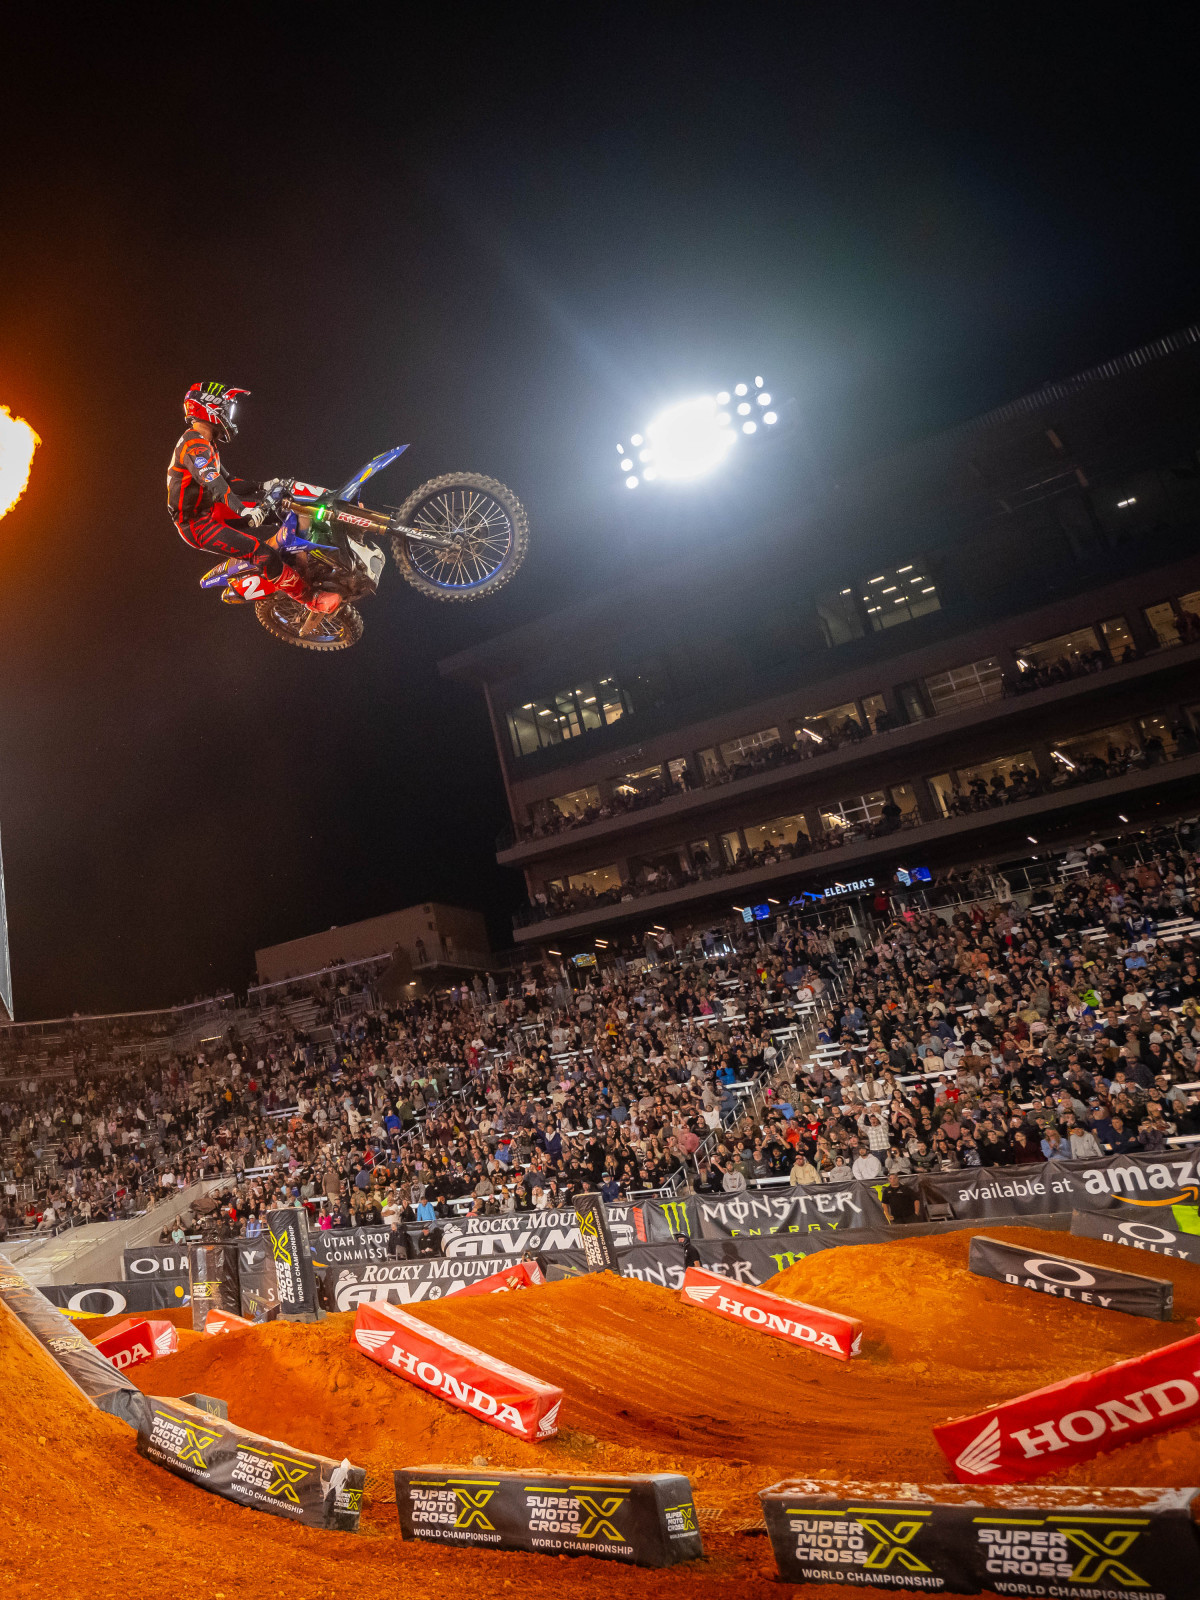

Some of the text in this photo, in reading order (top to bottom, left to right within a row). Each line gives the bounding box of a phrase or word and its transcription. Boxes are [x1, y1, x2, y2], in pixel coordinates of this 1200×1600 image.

[242, 575, 265, 600] 2
[824, 878, 875, 897] ELECTRA'S
[1082, 1161, 1200, 1195] amaz
[958, 1177, 1074, 1201] available at
[466, 1217, 523, 1235] ROCKY
[323, 1233, 390, 1248] UTAH SPOR
[1102, 1233, 1190, 1260] OAKLEY
[361, 1264, 424, 1282] ROCKY
[1005, 1273, 1112, 1307] OAKLEY
[717, 1295, 844, 1354] HONDA
[388, 1344, 528, 1433] HONDA
[1010, 1371, 1200, 1459] HOND
[152, 1416, 187, 1437] SUPER
[152, 1426, 184, 1445] MOTO
[149, 1434, 182, 1454] CROSS
[147, 1446, 211, 1479] WORLD CHAMPIONSHIP
[236, 1451, 274, 1472] SUPER
[236, 1461, 271, 1481] MOTO
[231, 1469, 271, 1490] CROSS
[231, 1483, 304, 1515] WORLD CHAMPIONSHIP
[409, 1489, 457, 1501] SUPER
[526, 1495, 580, 1510] SUPER
[413, 1500, 456, 1513] MOTO
[530, 1508, 579, 1521] MOTO
[411, 1511, 458, 1524] CROSS
[789, 1518, 864, 1536] SUPER
[413, 1528, 502, 1543] WORLD CHAMPIONSHIP
[528, 1520, 581, 1535] CROSS
[531, 1538, 634, 1555] WORLD CHAMPIONSHIP
[797, 1533, 864, 1550] MOTO
[977, 1528, 1068, 1547] SUPER
[795, 1547, 868, 1564] CROSS
[987, 1545, 1068, 1562] MOTO
[801, 1568, 945, 1588] WORLD CHAMPIONSHIP
[986, 1560, 1073, 1577] CROSS
[994, 1582, 1166, 1600] WORLD CHAMPIONSHIP
